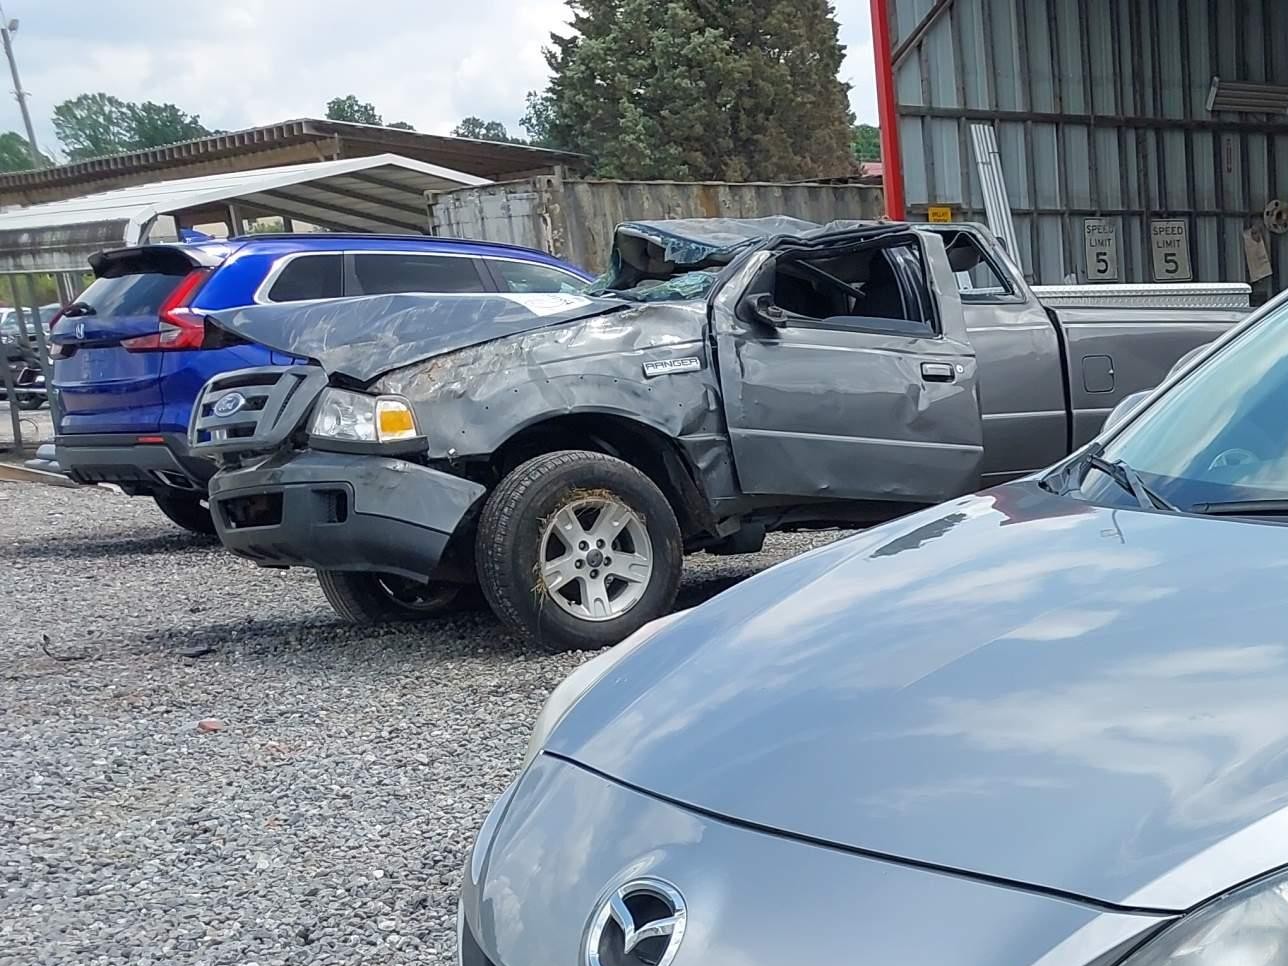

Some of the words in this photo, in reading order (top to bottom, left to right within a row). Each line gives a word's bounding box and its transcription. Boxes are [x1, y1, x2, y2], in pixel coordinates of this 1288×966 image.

[1086, 224, 1114, 234] SPEED
[1152, 226, 1184, 236] SPEED
[1089, 239, 1112, 247] LIMIT
[1156, 240, 1181, 249] LIMIT
[1095, 251, 1109, 274] 5
[1164, 252, 1179, 274] 5
[645, 359, 699, 371] RANGER
